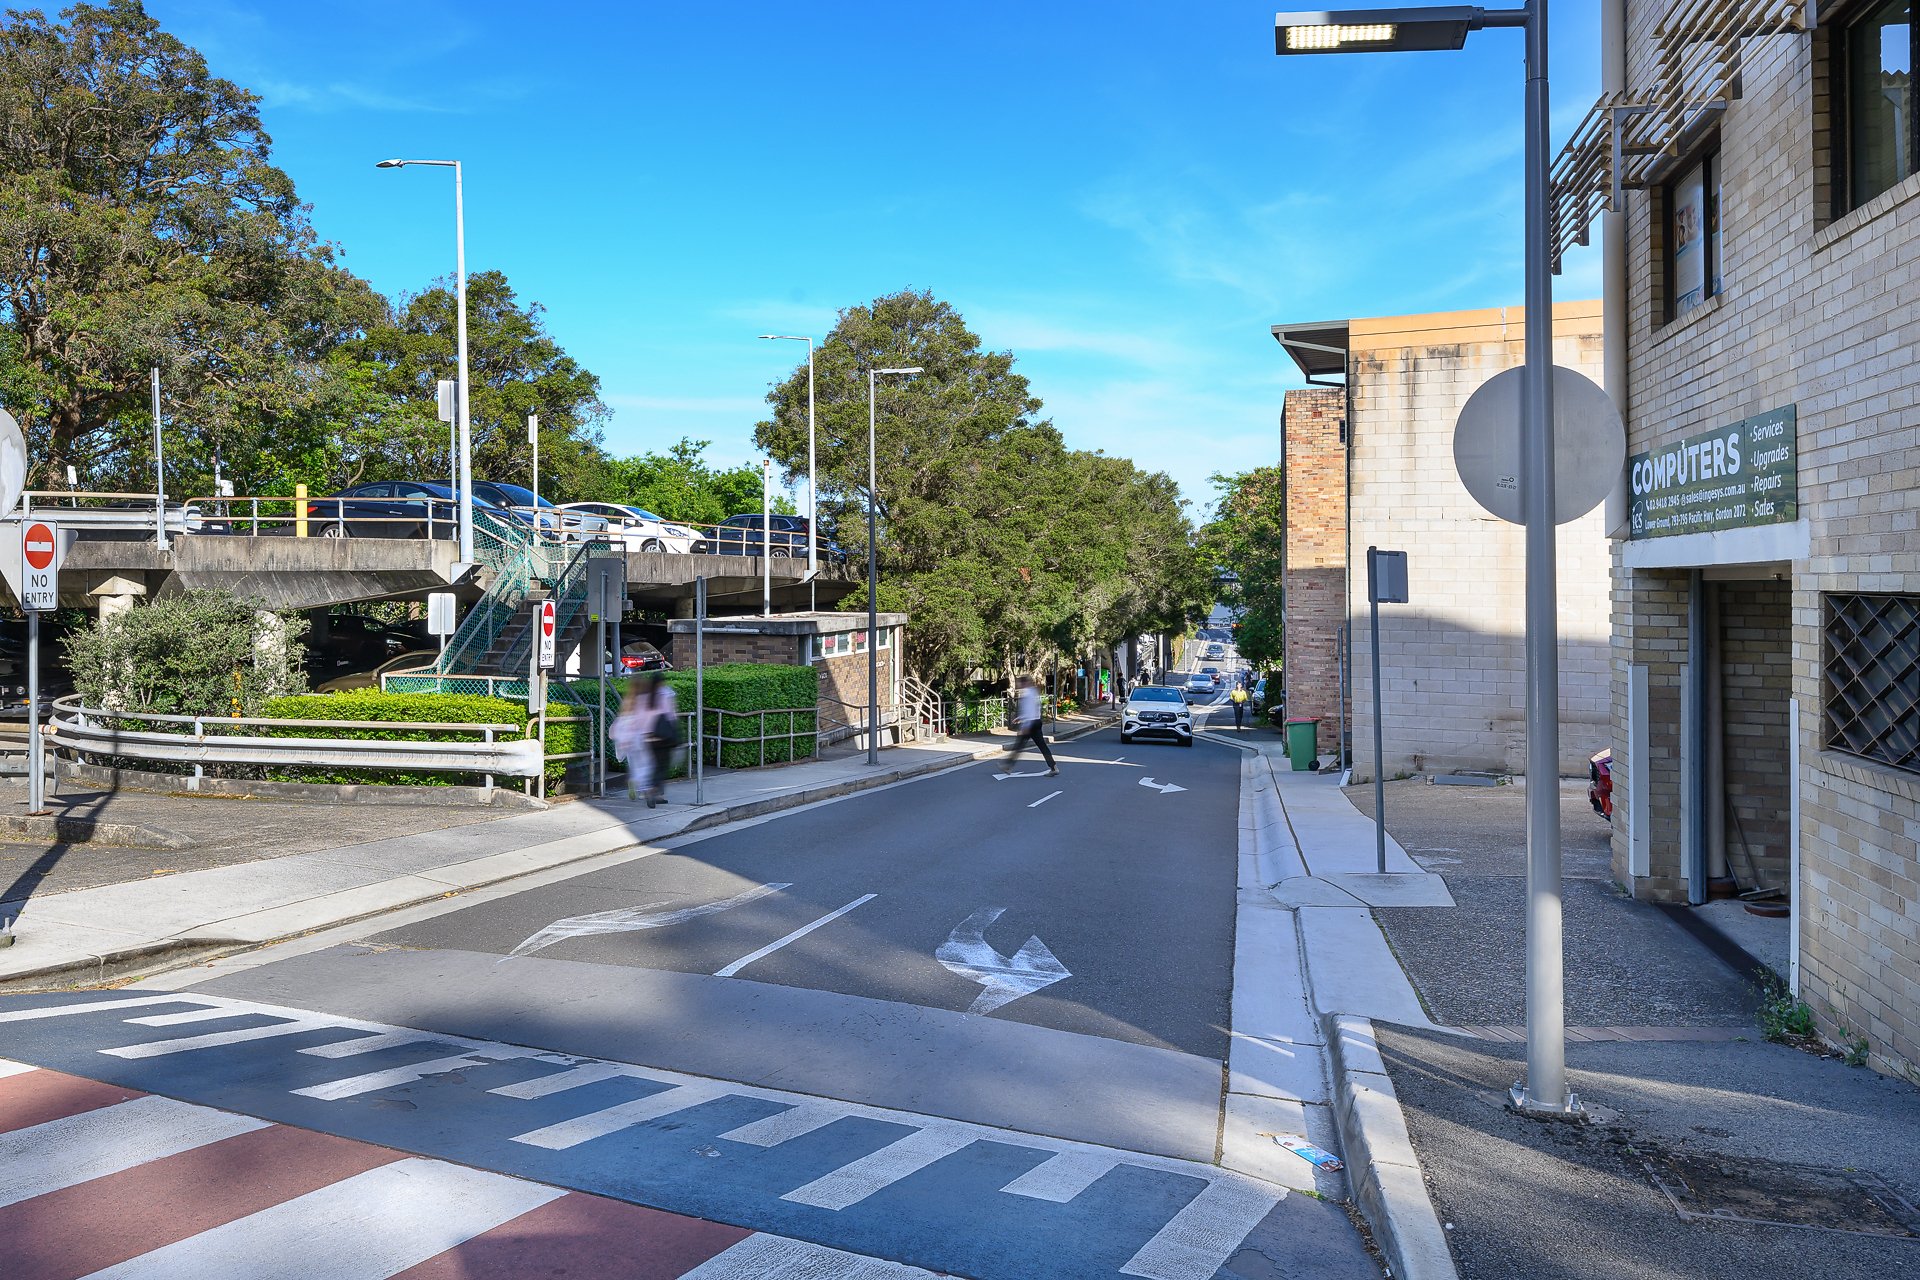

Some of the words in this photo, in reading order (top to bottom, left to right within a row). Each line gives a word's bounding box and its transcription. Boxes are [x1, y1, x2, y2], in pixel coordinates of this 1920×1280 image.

[1753, 420, 1783, 442] Services
[1632, 433, 1740, 495] COMPUTERS
[1753, 443, 1789, 471] Upgrades
[1753, 472, 1782, 495] Repairs
[1688, 510, 1703, 524] Pacific
[1715, 506, 1732, 520] Gordon
[1733, 503, 1746, 518] 2072
[1754, 499, 1775, 518] Sales
[31, 575, 48, 588] NO
[25, 592, 54, 603] ENTRY
[544, 640, 552, 650] NO
